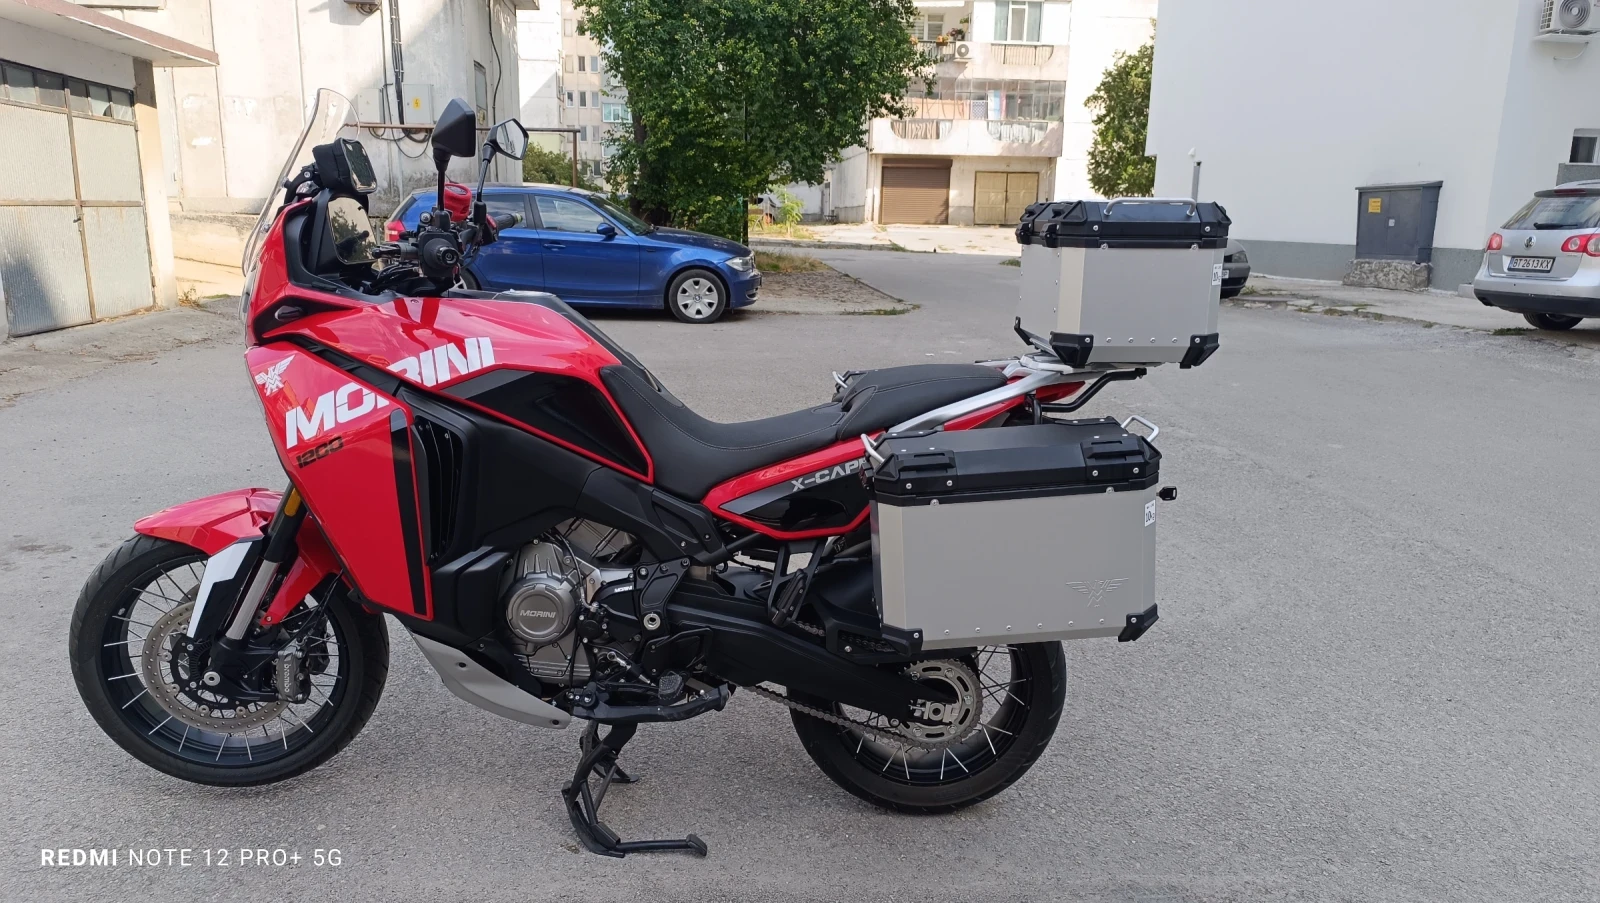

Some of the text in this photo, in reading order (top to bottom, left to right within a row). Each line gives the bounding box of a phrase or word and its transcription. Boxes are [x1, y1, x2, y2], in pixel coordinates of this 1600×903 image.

[296, 436, 343, 468] 1200
[520, 609, 556, 618] MORINI
[283, 663, 291, 693] brembo
